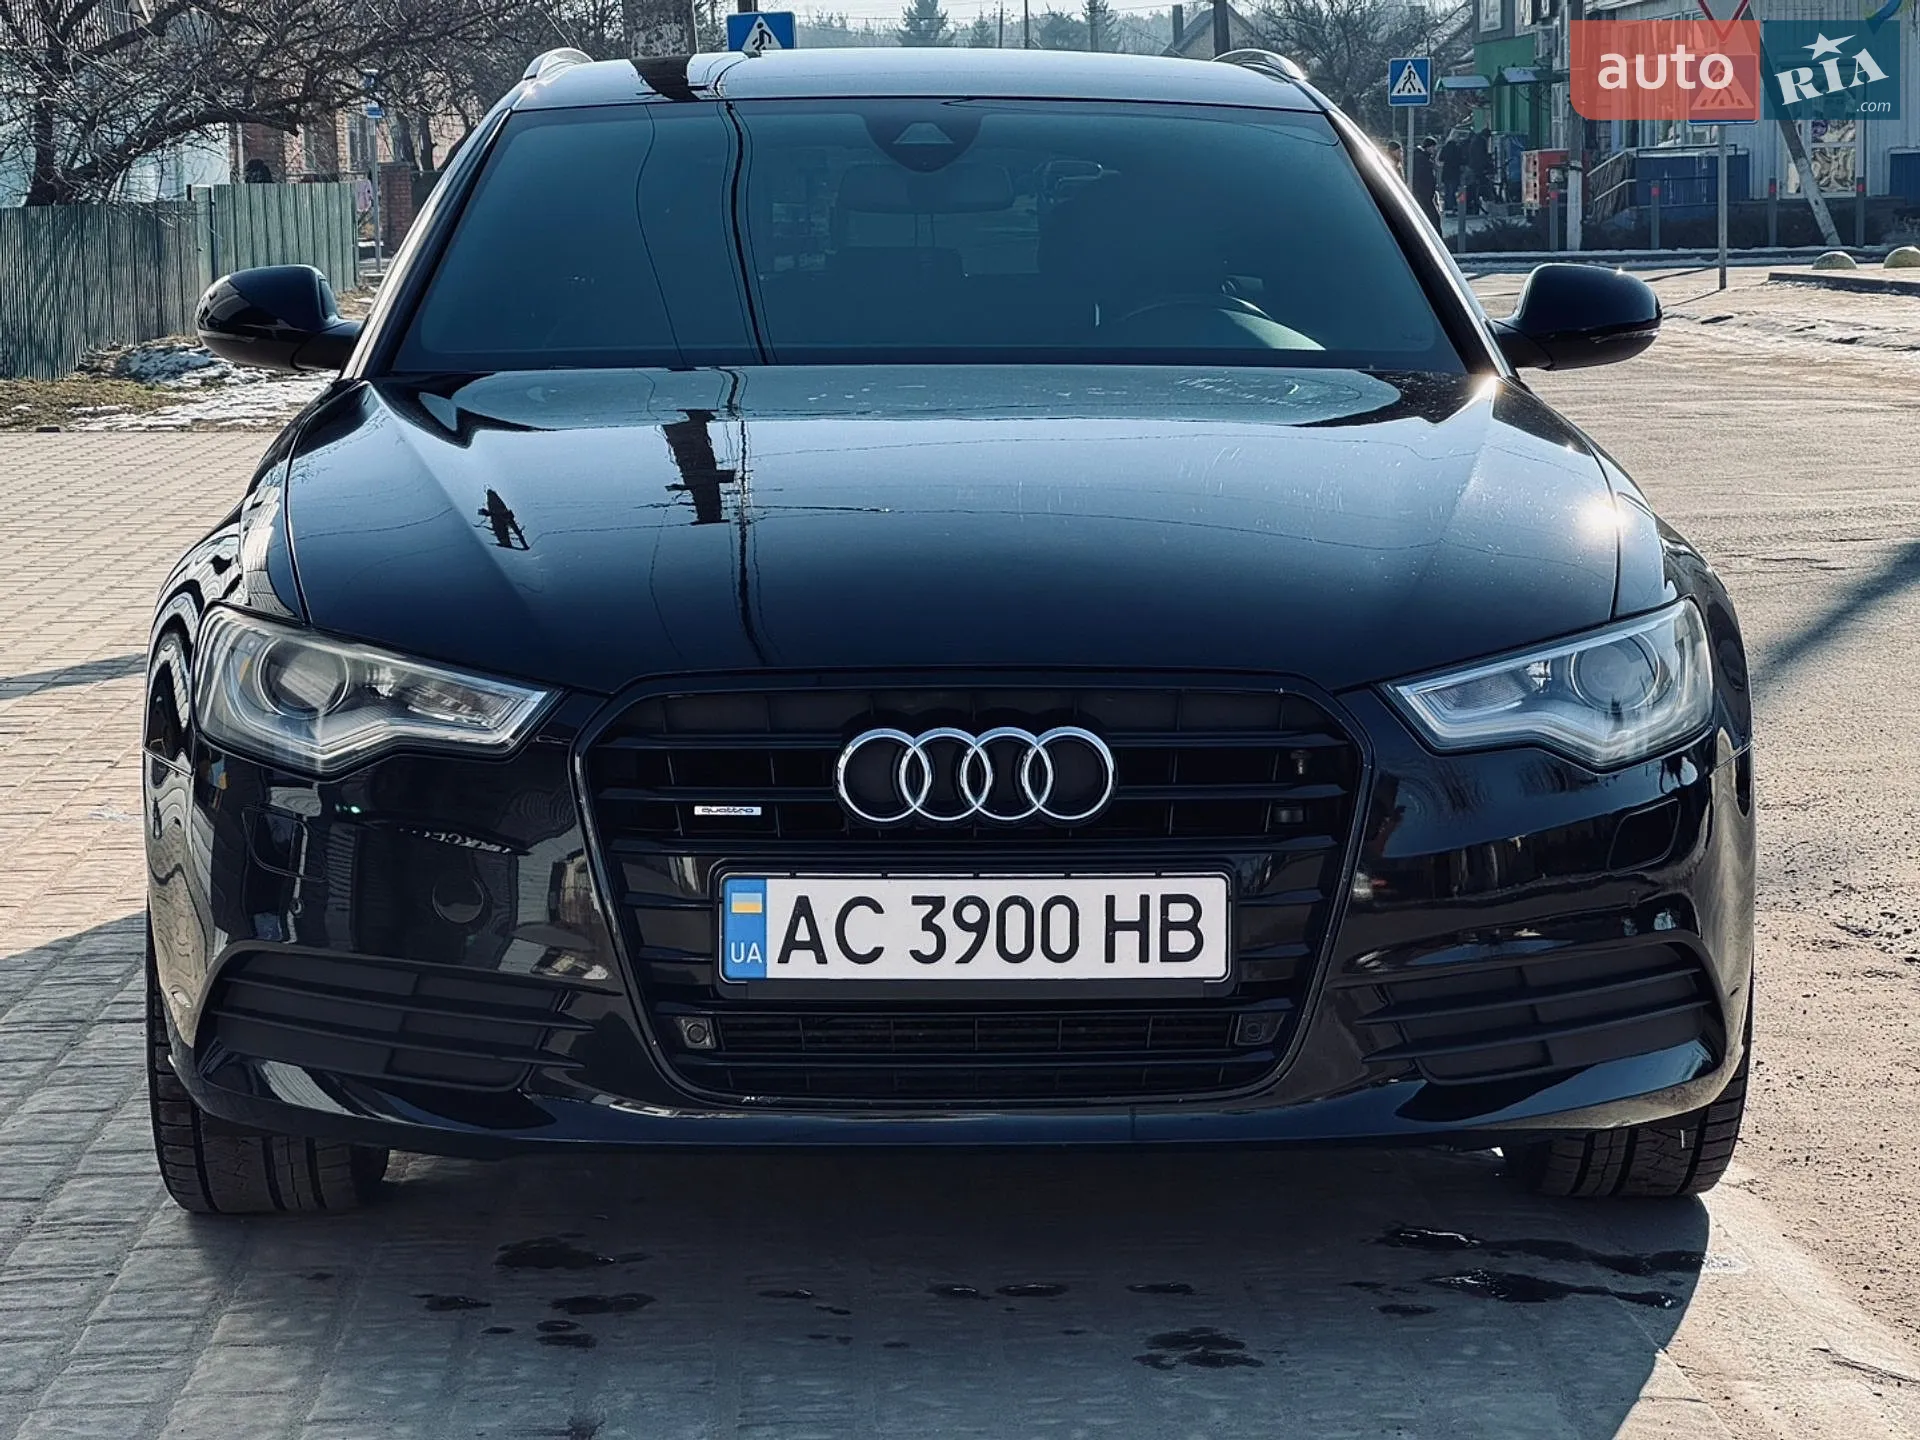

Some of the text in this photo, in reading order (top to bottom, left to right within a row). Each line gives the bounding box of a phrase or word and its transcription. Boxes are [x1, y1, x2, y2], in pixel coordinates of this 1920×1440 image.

[700, 806, 756, 814] quattro
[777, 893, 1205, 965] AC 3900 HB
[730, 942, 763, 964] UA
